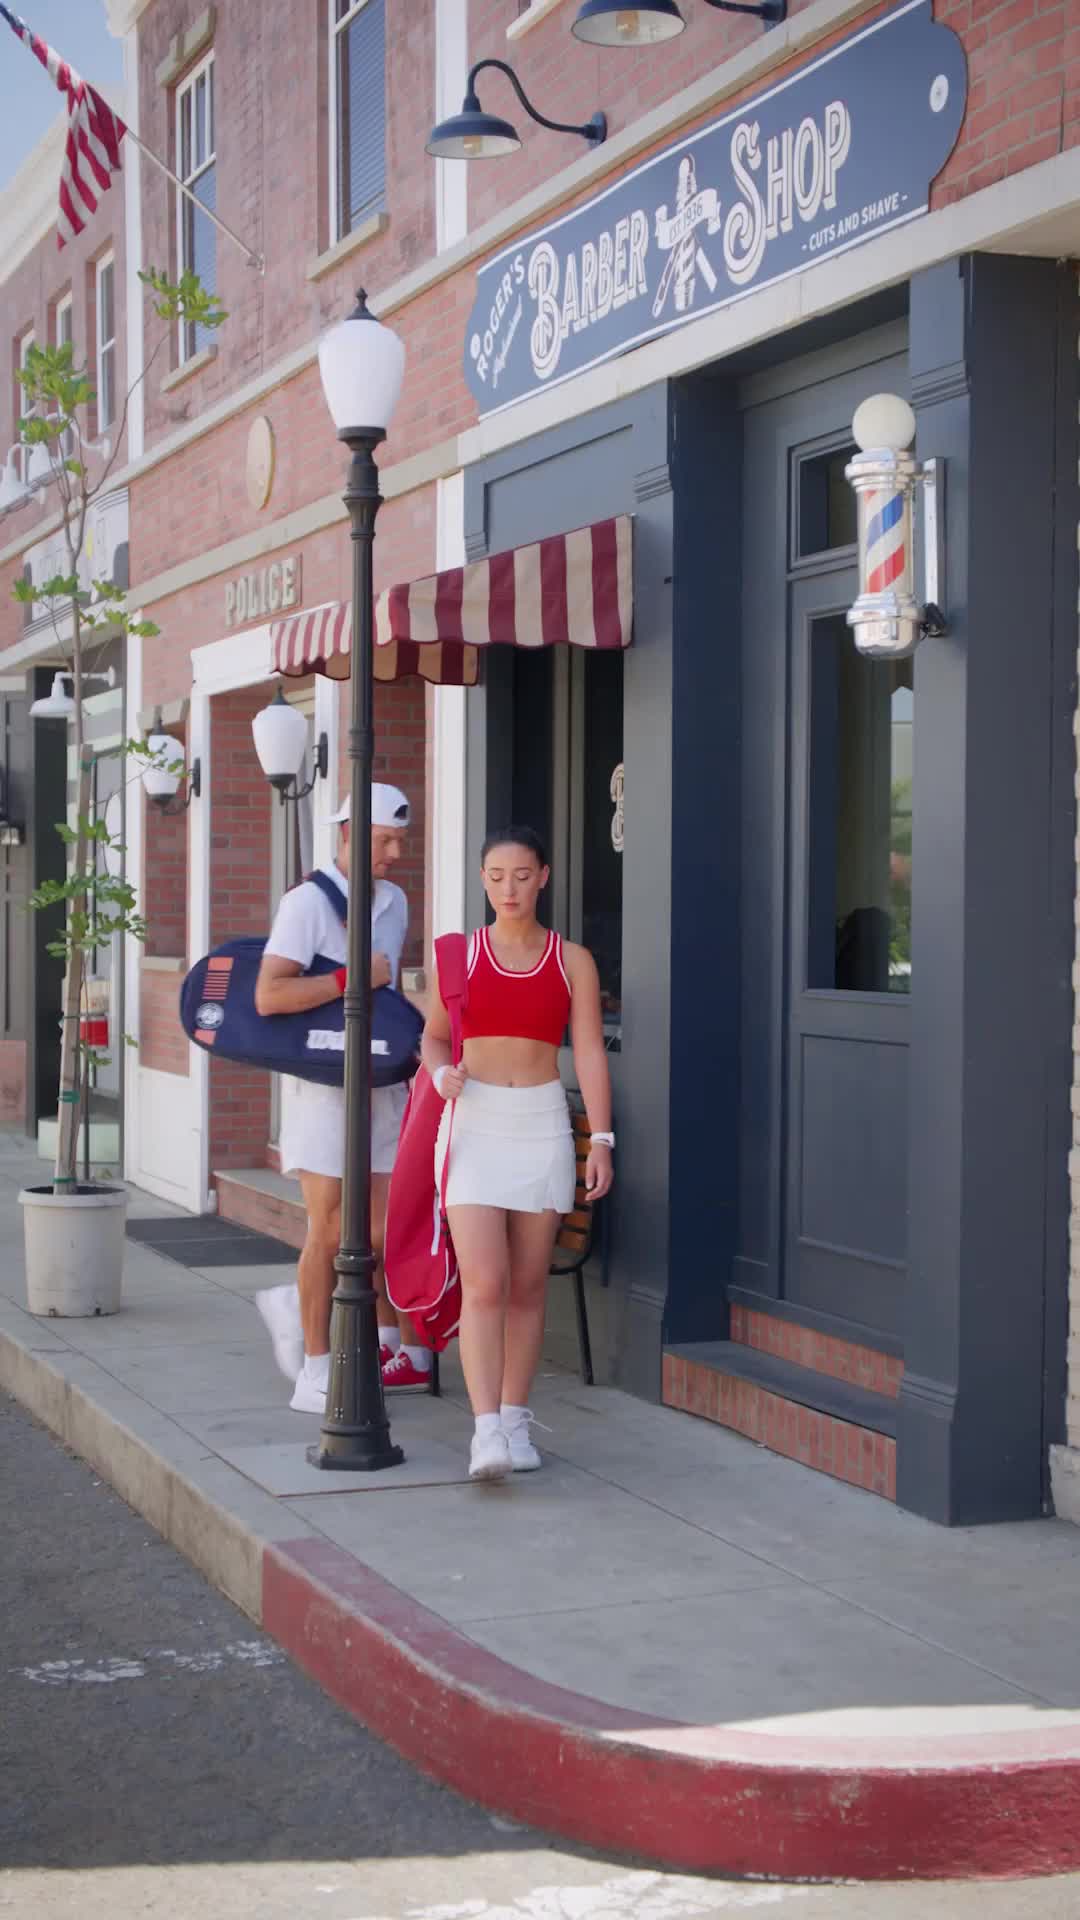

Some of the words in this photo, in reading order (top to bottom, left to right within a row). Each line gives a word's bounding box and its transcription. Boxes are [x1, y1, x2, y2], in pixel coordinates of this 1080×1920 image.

[528, 209, 649, 380] BARBER
[723, 100, 851, 286] SHOP
[808, 223, 835, 251] CUTS
[836, 211, 860, 239] AND
[861, 191, 900, 225] SHAVE
[476, 252, 525, 383] ROGER'S
[223, 556, 298, 629] POLICE
